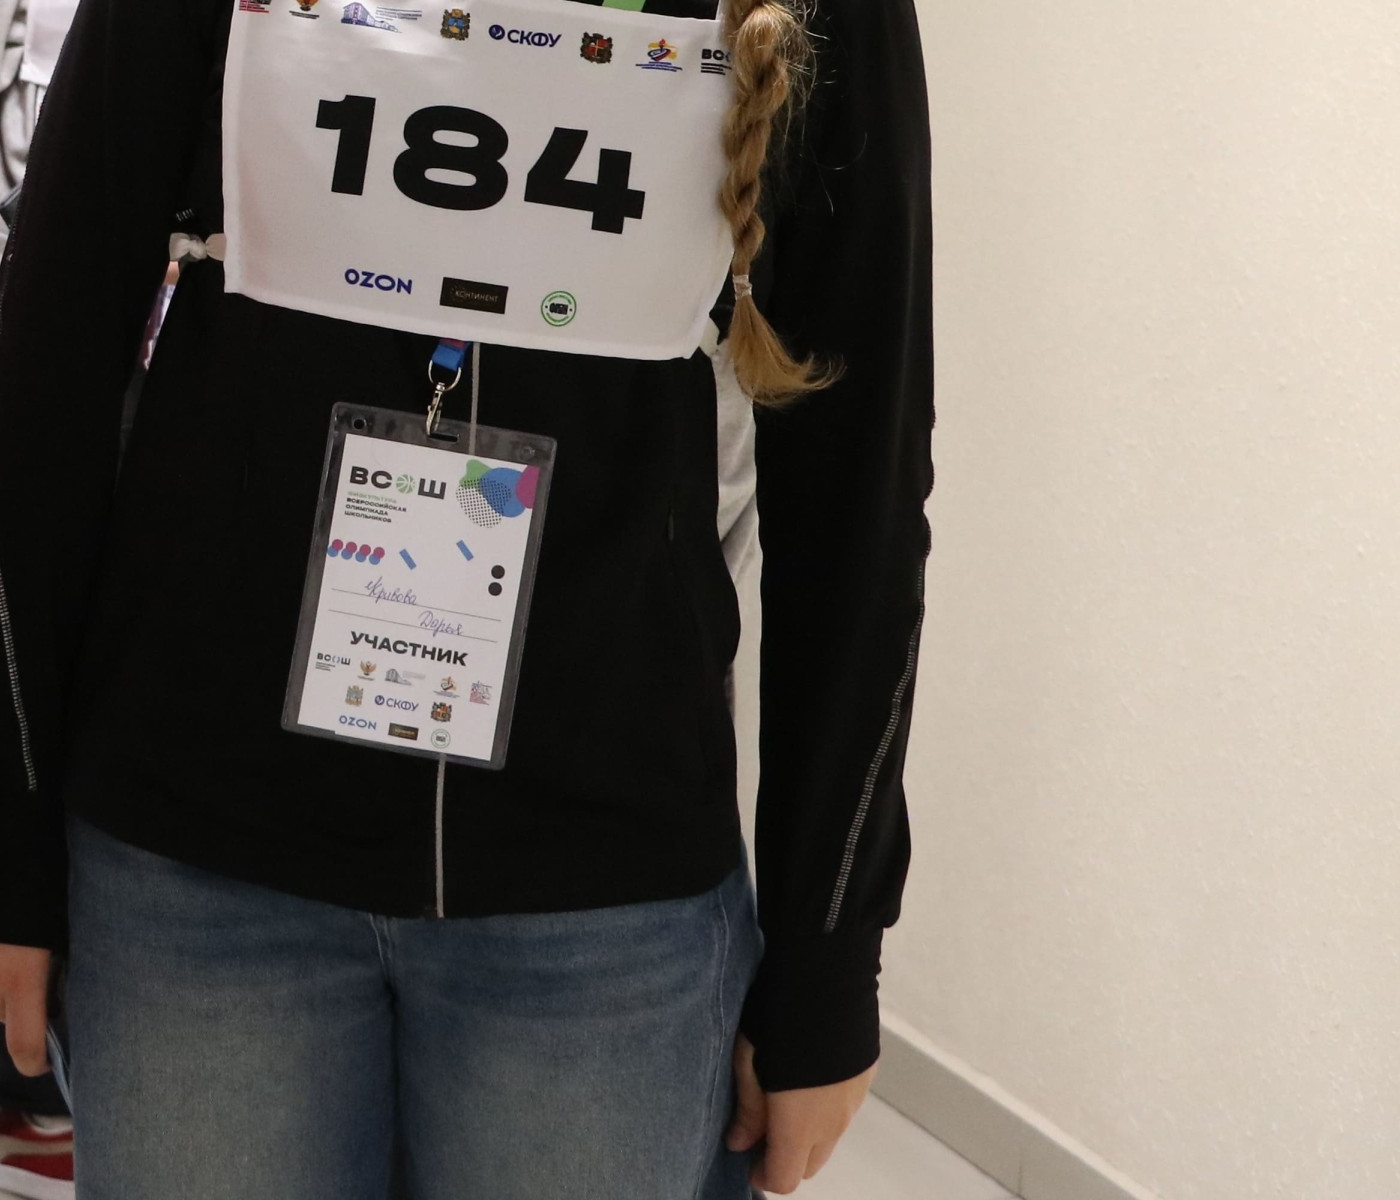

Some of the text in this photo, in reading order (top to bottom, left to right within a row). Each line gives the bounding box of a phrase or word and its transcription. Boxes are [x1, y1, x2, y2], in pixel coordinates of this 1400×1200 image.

[507, 29, 561, 47] СКФУ
[315, 94, 646, 234] 184
[344, 268, 412, 295] OZON
[345, 504, 388, 516] ОЛИМПИАДА
[346, 497, 407, 512] ВСЕРОССИЙСКАЯ
[344, 510, 392, 523] ШКОЛЬНИКОВ
[350, 630, 469, 666] УЧАСТНИК
[386, 697, 419, 712] СКФУ
[339, 715, 377, 731] OZON
